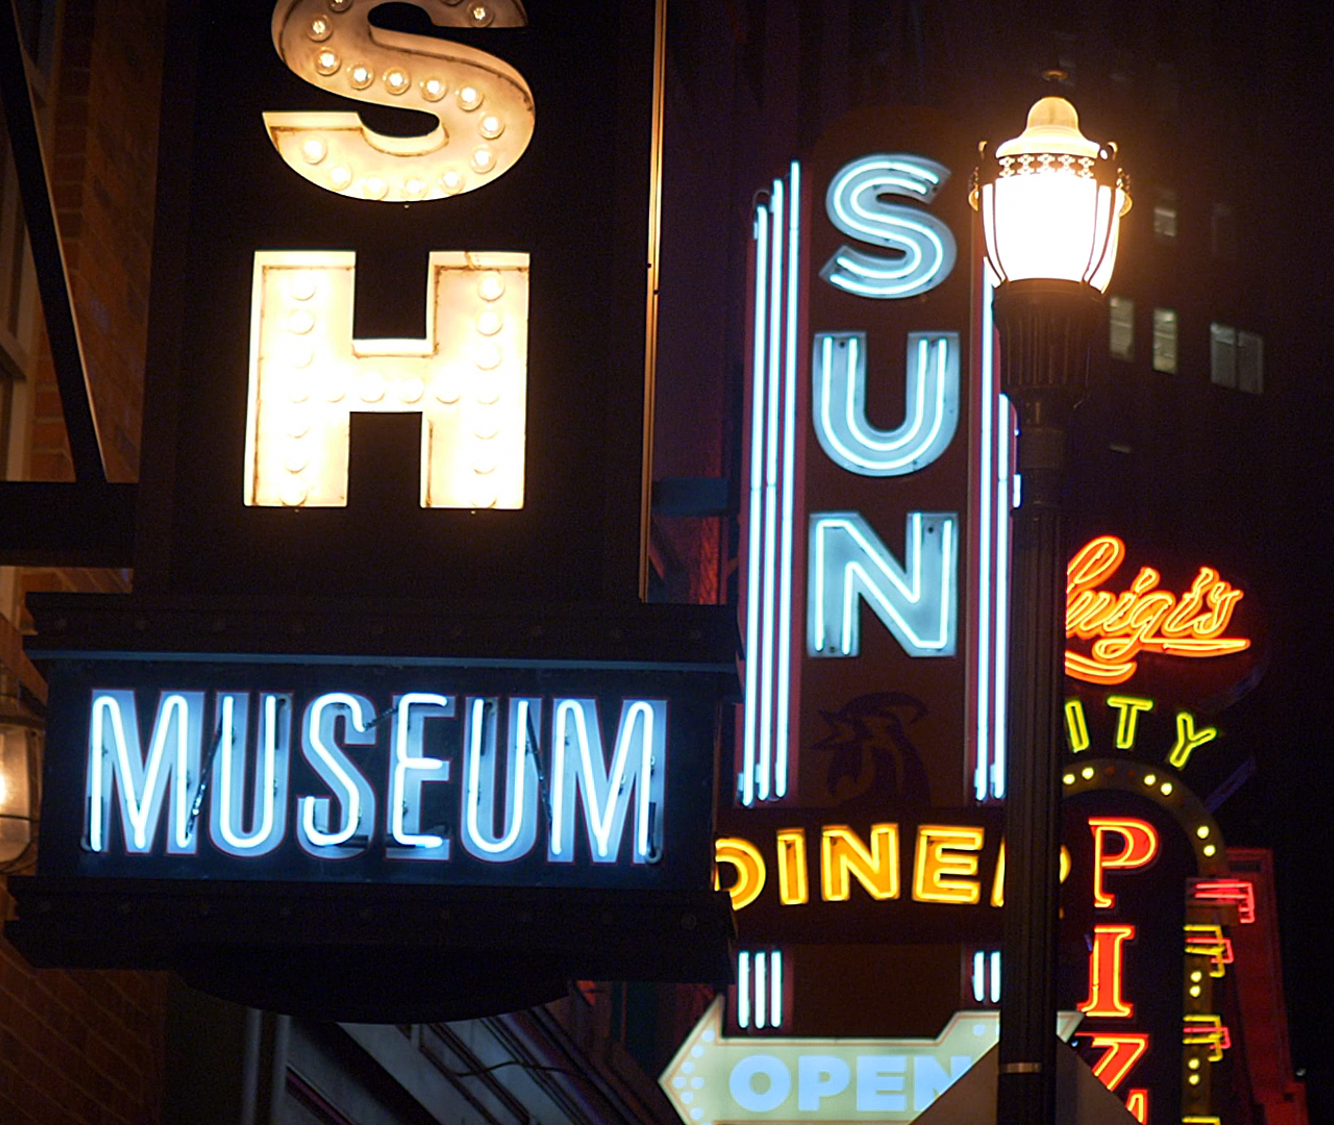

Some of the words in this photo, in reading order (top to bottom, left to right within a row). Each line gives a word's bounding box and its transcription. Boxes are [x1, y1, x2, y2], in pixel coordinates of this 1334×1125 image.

[806, 152, 960, 659] SUN
[85, 688, 668, 864] MUSEUM
[715, 823, 1071, 919] DINE
